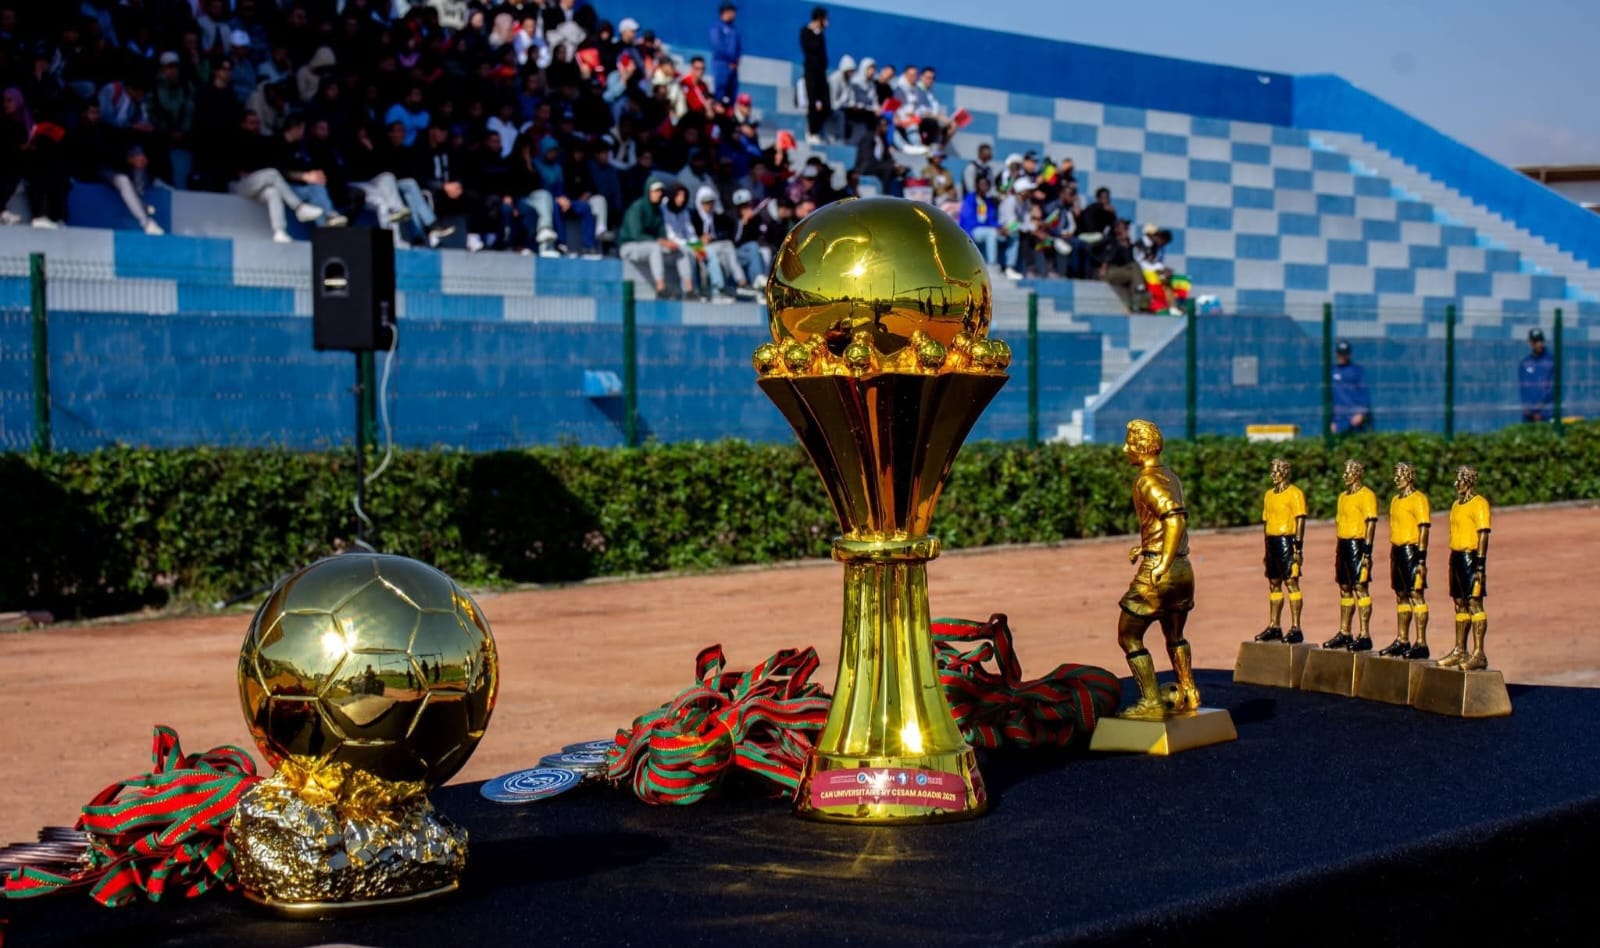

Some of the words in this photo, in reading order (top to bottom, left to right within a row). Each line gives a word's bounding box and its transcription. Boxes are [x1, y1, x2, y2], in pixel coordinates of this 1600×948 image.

[820, 791, 833, 799] CAN
[891, 789, 916, 797] CESAM
[917, 790, 941, 799] AGADIR
[942, 792, 956, 801] 2025
